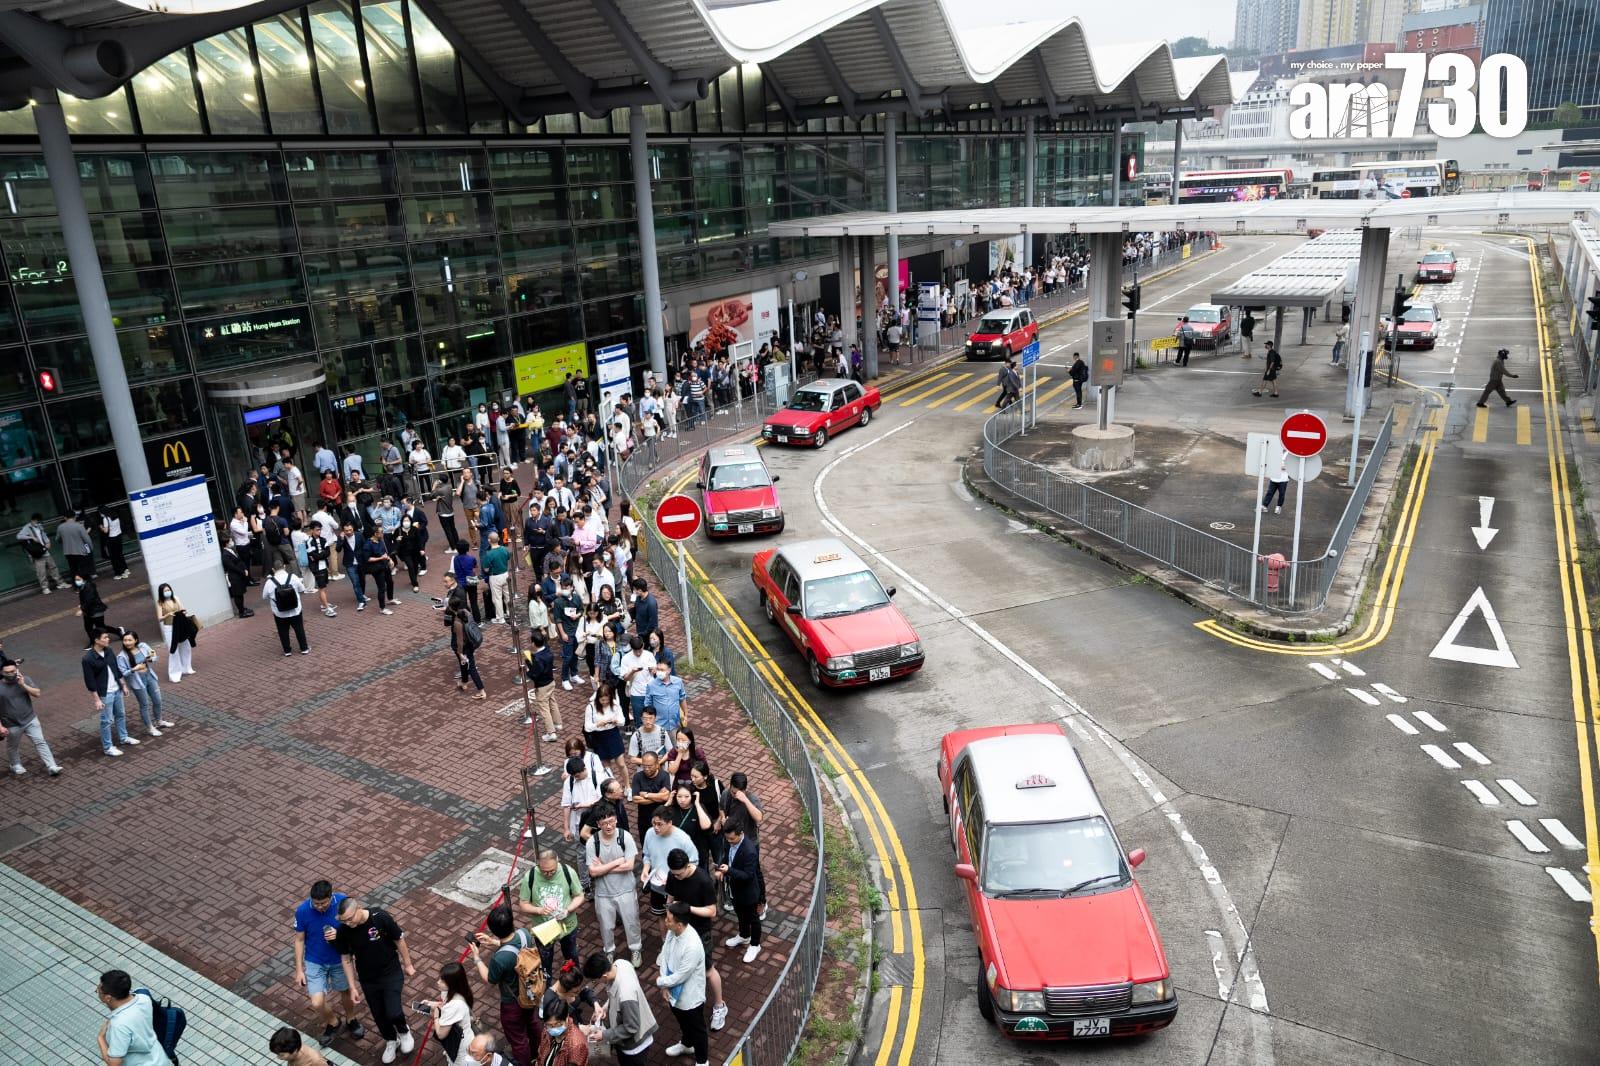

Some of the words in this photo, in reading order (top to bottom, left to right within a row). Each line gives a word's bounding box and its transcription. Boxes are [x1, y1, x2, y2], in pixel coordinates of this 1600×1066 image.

[253, 323, 269, 331] Hung
[1084, 1018, 1100, 1028] JV
[1076, 1026, 1107, 1036] 7770
